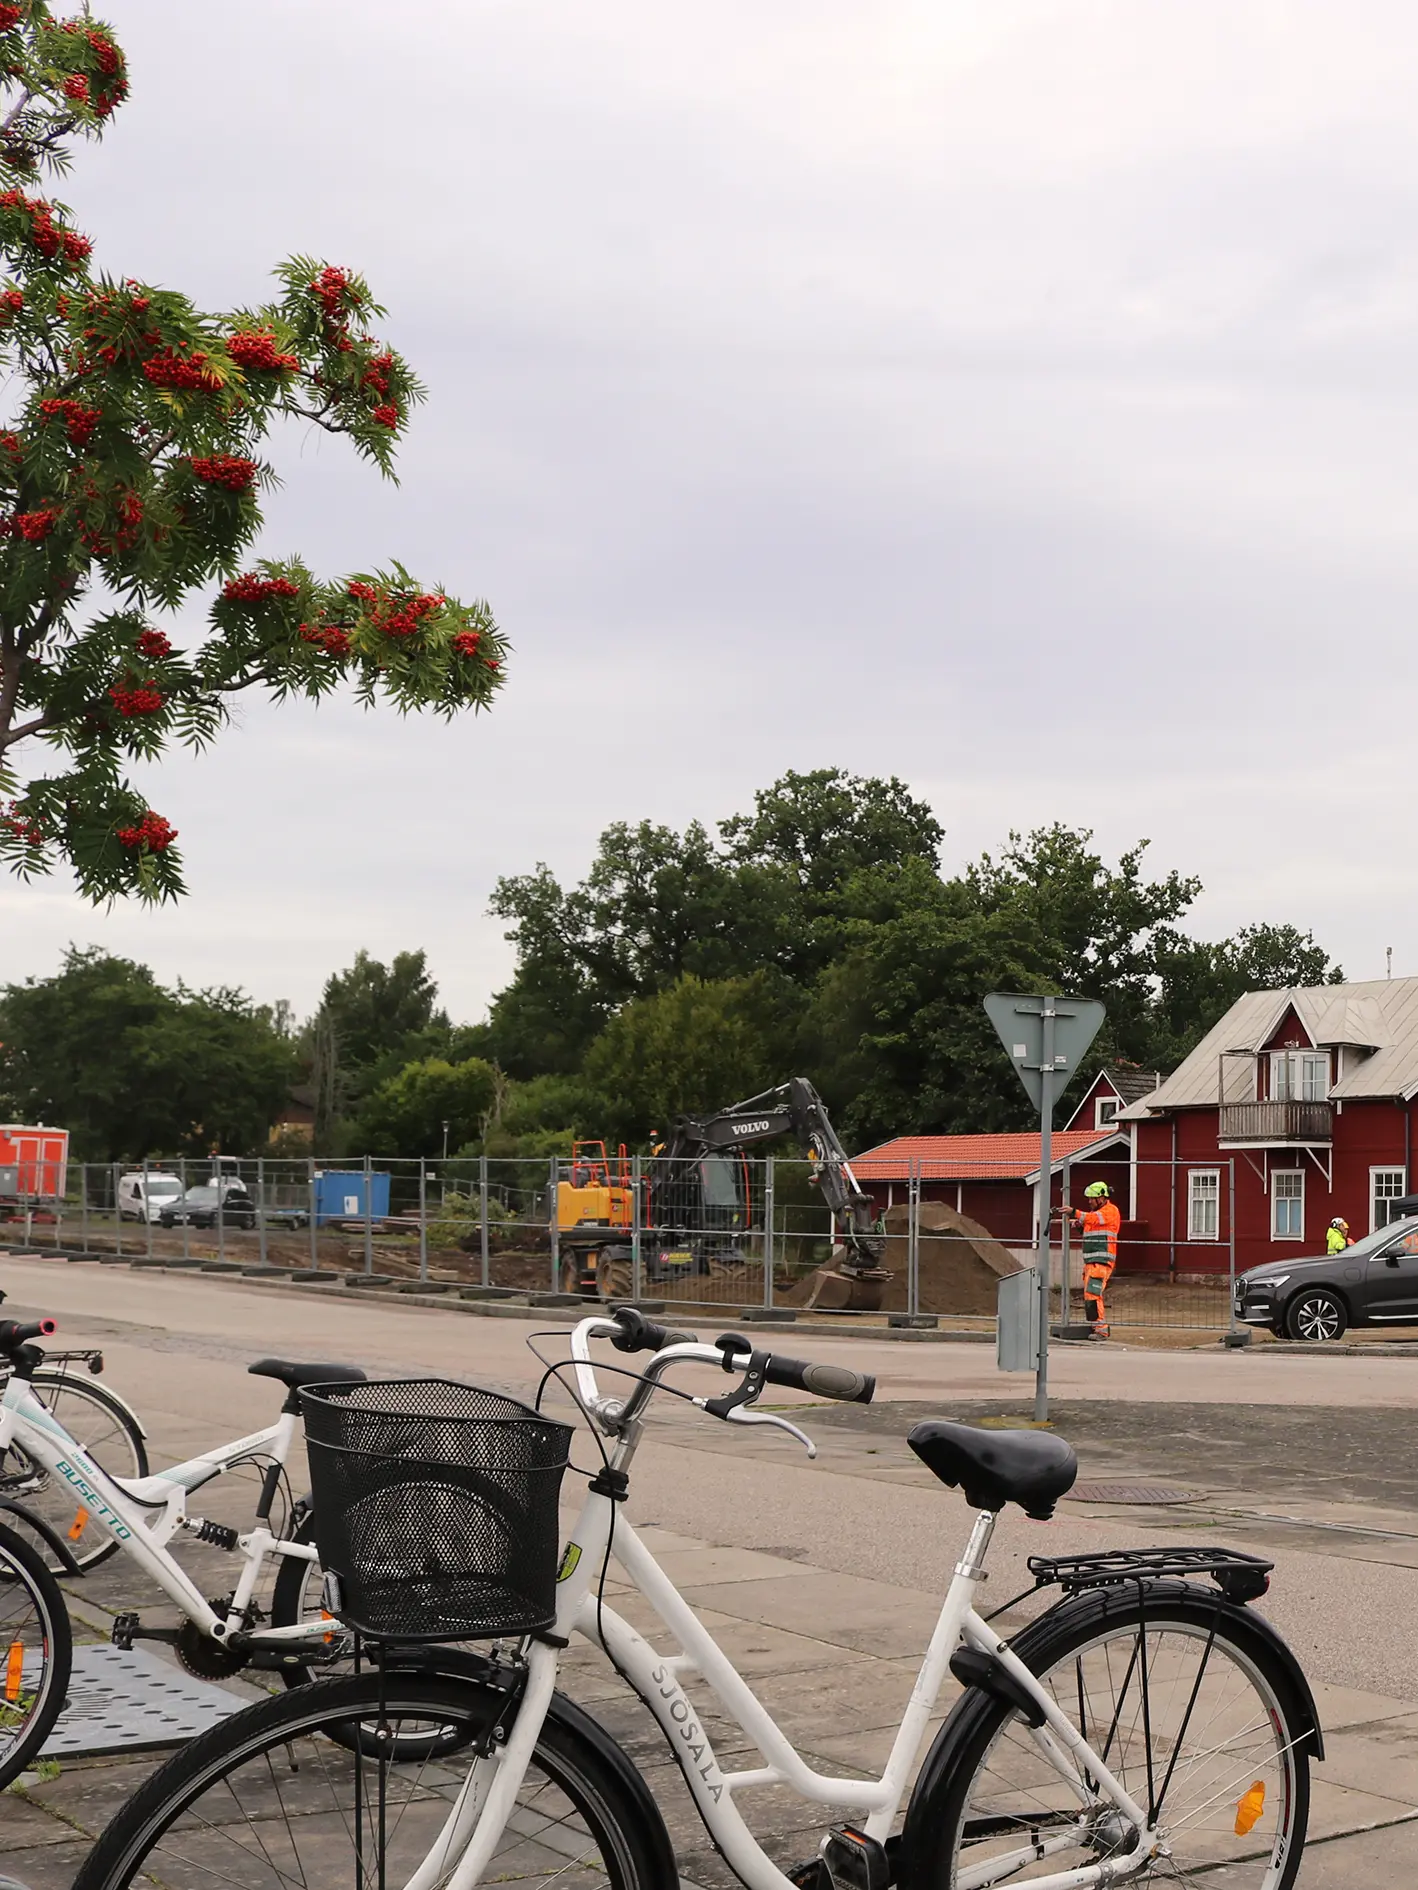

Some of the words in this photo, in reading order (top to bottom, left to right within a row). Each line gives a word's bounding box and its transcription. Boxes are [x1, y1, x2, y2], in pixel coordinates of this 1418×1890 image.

[731, 1120, 770, 1135] VOLVO
[55, 1461, 132, 1541] BUSETTO
[651, 1664, 724, 1805] SJÖSALA
